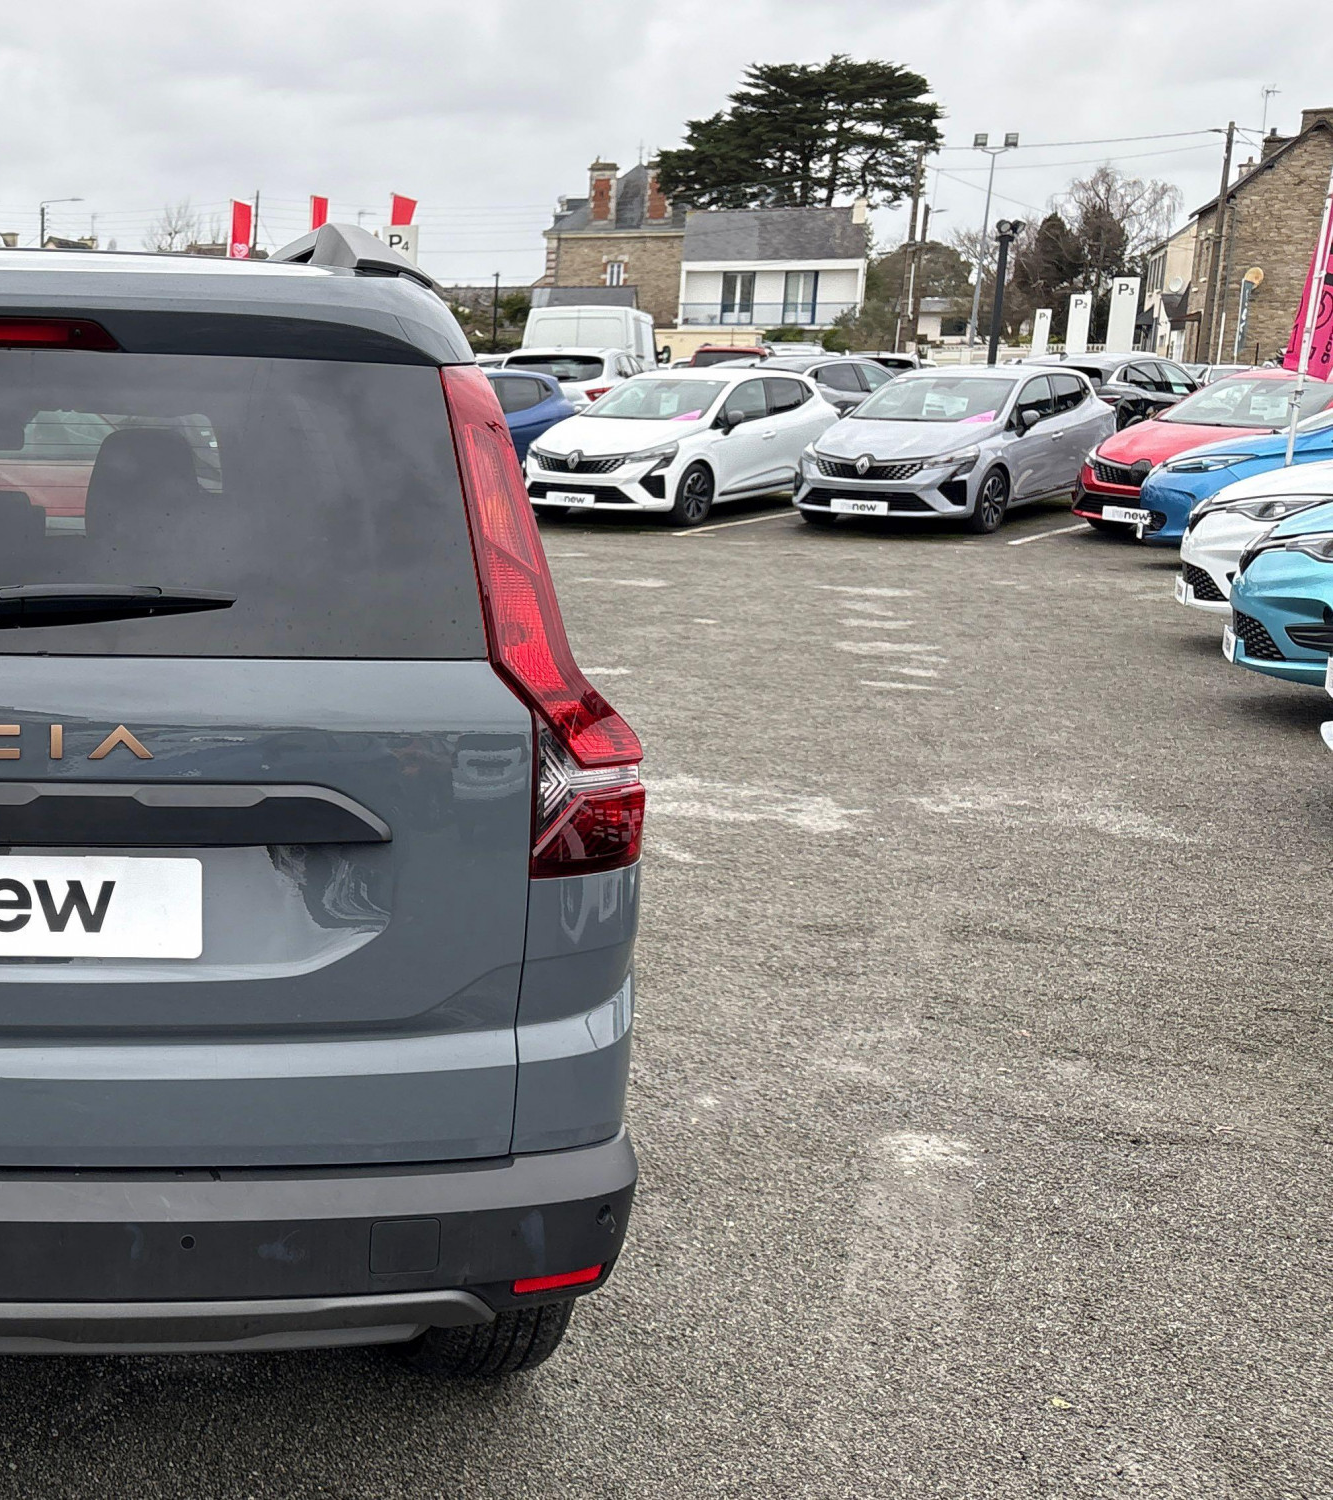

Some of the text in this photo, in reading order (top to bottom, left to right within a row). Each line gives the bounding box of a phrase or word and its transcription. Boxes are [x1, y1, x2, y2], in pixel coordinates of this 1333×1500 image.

[1118, 283, 1135, 296] P3
[554, 495, 586, 504] new
[840, 502, 877, 512] new
